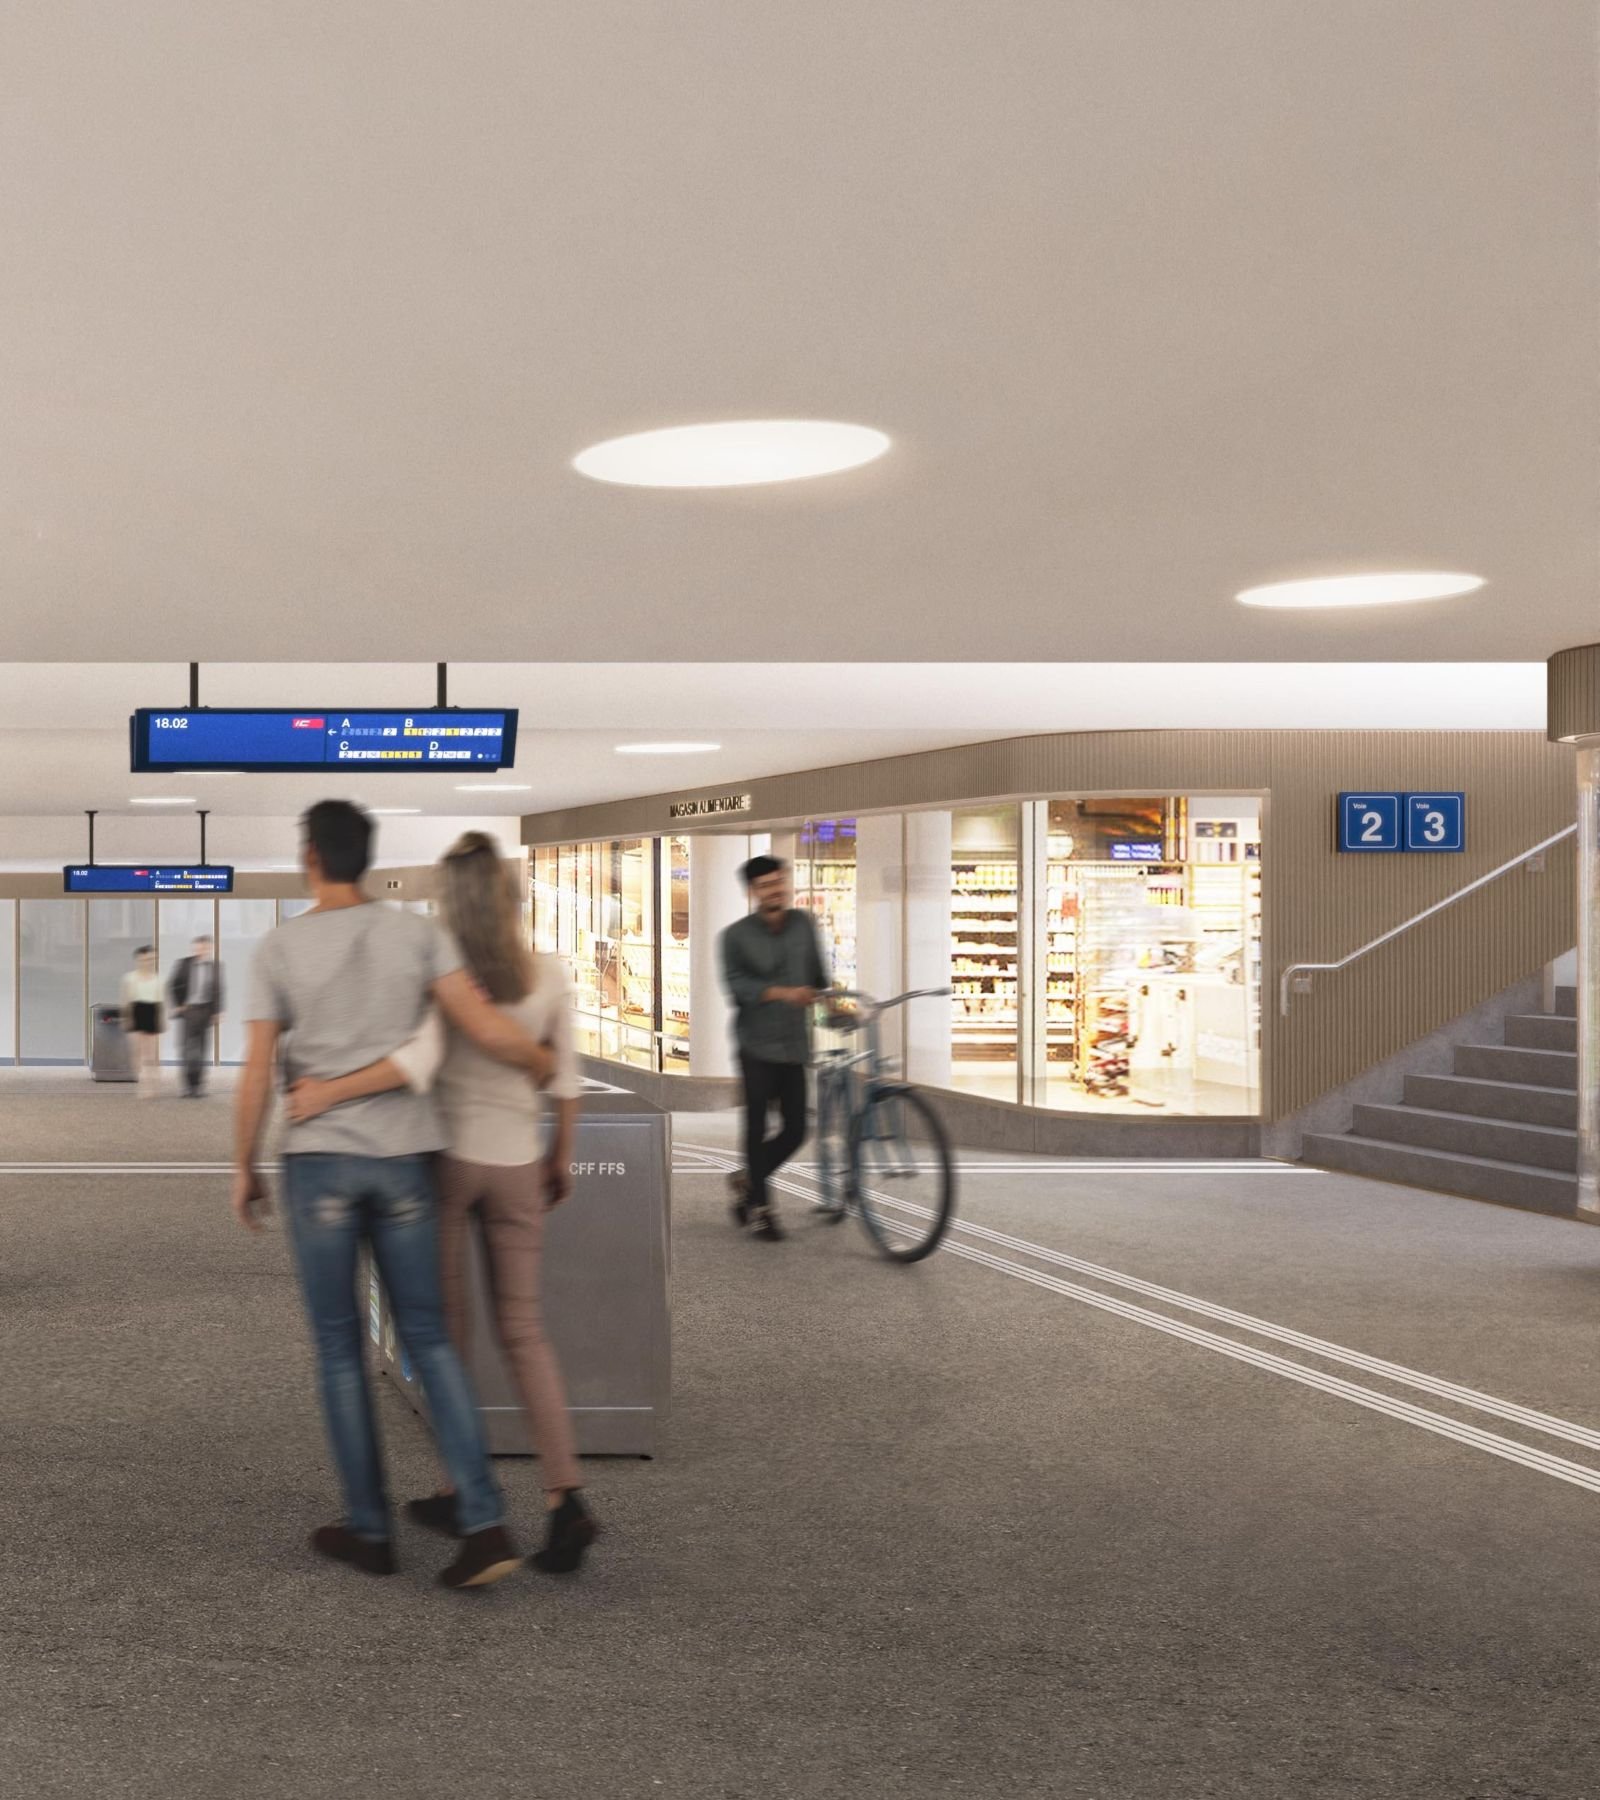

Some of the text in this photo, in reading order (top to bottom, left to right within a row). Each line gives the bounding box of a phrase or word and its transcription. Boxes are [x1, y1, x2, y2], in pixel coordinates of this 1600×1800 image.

[155, 718, 188, 729] 18.02
[341, 718, 414, 727] A B
[340, 741, 439, 750] C D
[670, 795, 744, 817] MAGASIN ALIMENTAIRE
[1361, 812, 1382, 842] 2
[1424, 812, 1446, 842] 3
[569, 1162, 626, 1175] CFF FFS
